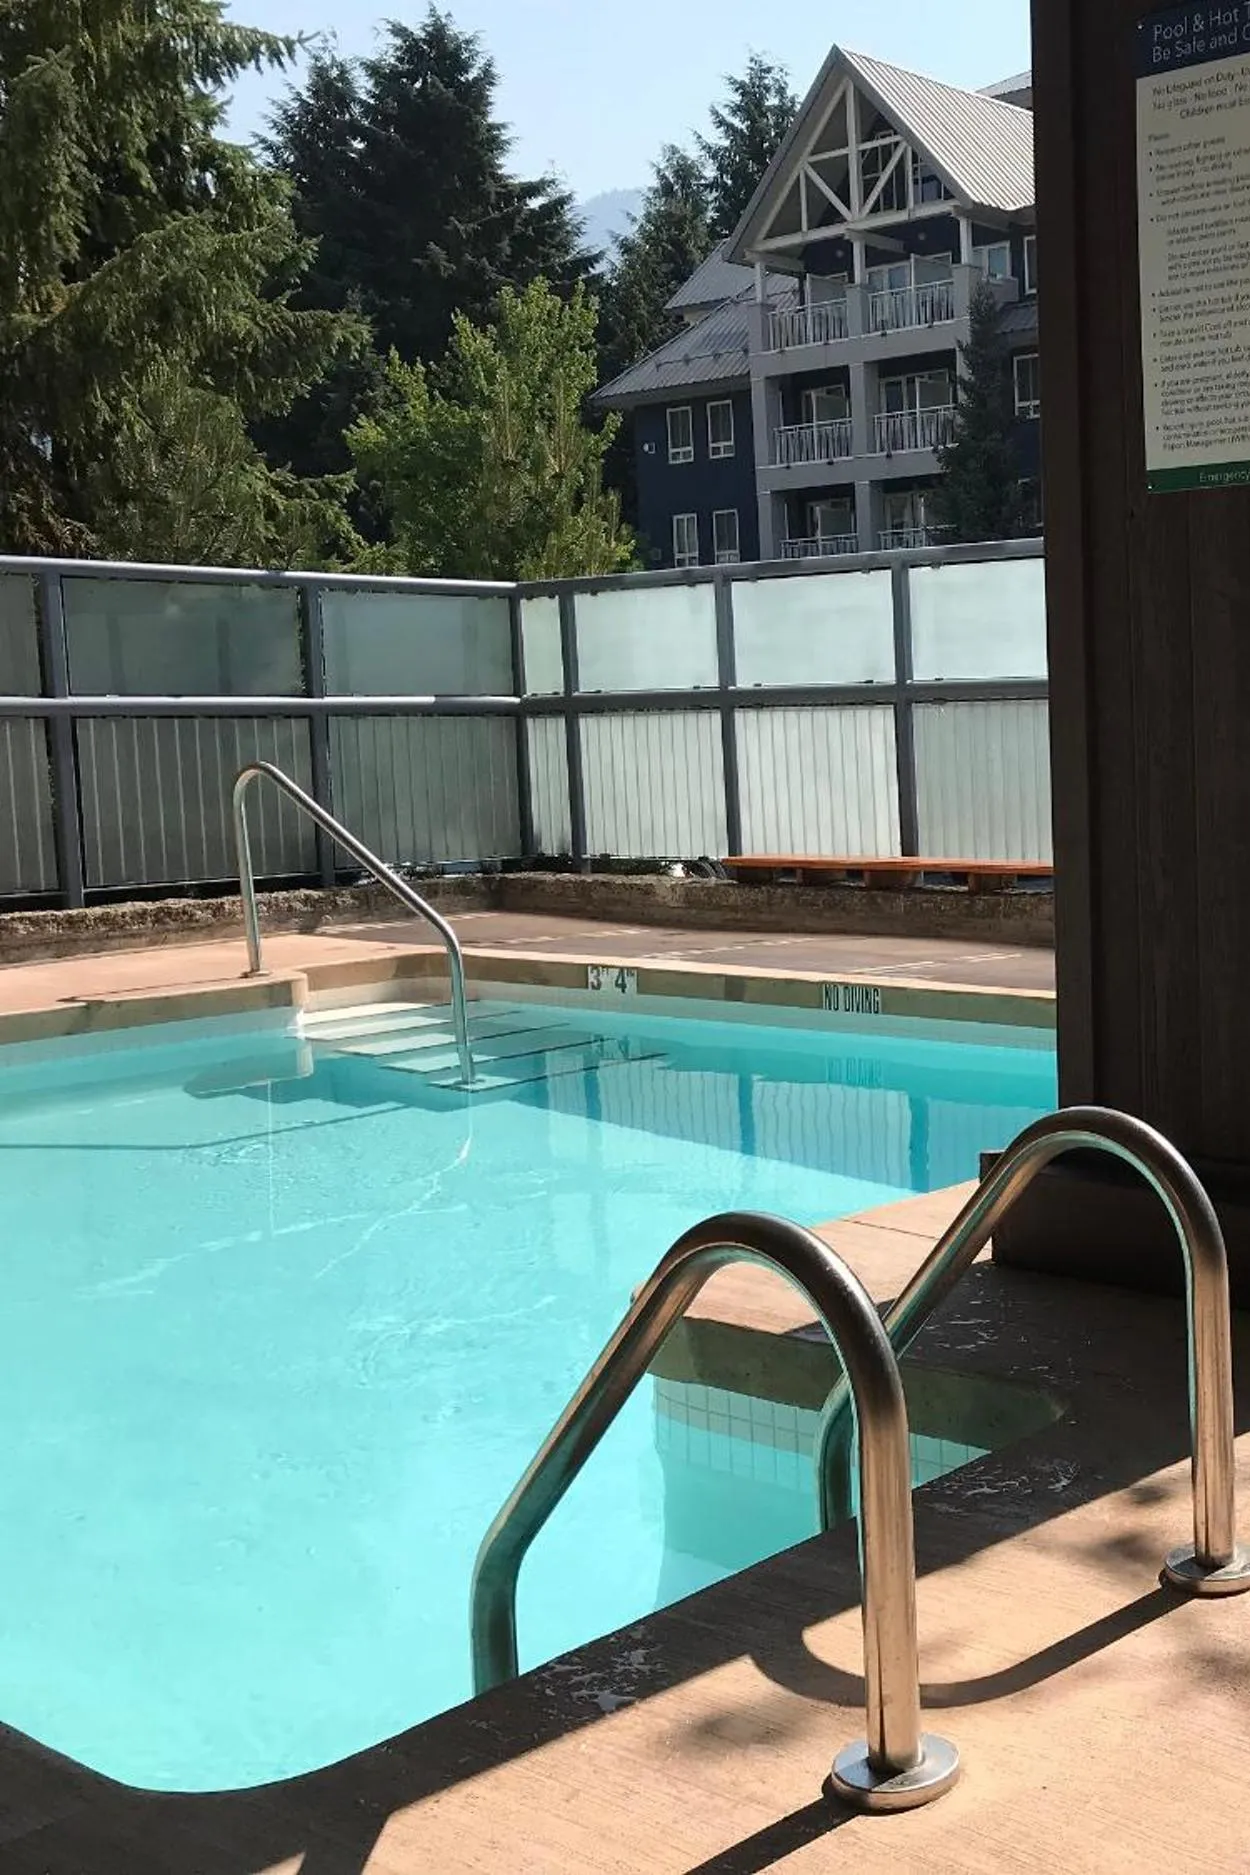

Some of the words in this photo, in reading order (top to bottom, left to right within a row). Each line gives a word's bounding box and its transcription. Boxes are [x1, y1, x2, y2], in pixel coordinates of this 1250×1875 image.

[1153, 15, 1187, 42] Pool
[1192, 12, 1203, 32] &
[1209, 3, 1239, 28] Hot
[1152, 43, 1170, 63] Be
[1174, 33, 1205, 57] Safe
[1209, 27, 1237, 49] and
[1216, 70, 1233, 84] Duty
[824, 983, 839, 1012] NO
[844, 985, 880, 1015] DIVING
